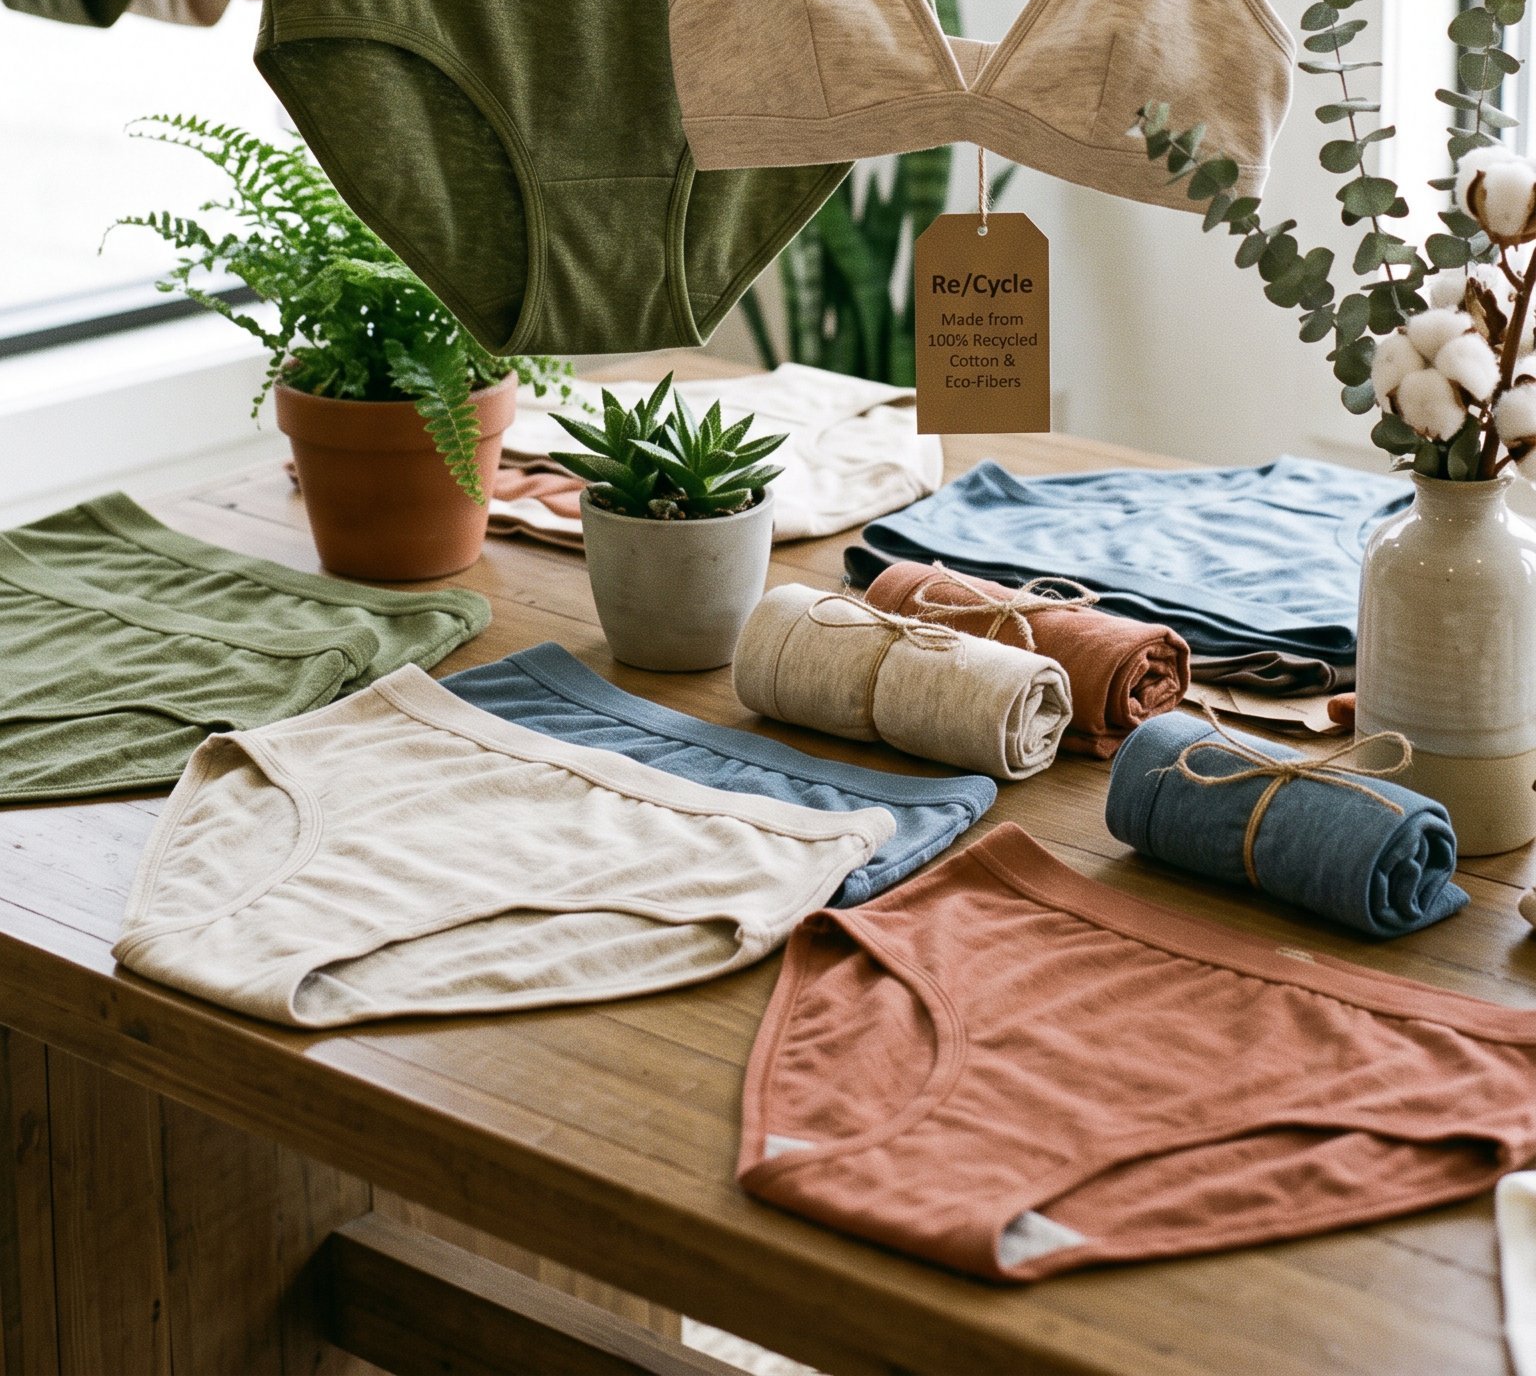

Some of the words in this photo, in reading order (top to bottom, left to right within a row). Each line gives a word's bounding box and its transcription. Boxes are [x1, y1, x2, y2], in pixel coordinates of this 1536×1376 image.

[932, 273, 1034, 298] Re/Cycle
[941, 312, 984, 326] Made
[988, 311, 1024, 326] from
[928, 333, 969, 347] 100%
[973, 332, 1038, 349] Recycled
[949, 354, 999, 368] Cotton
[1003, 353, 1016, 368] &
[945, 374, 1021, 389] Eco-Fibers
